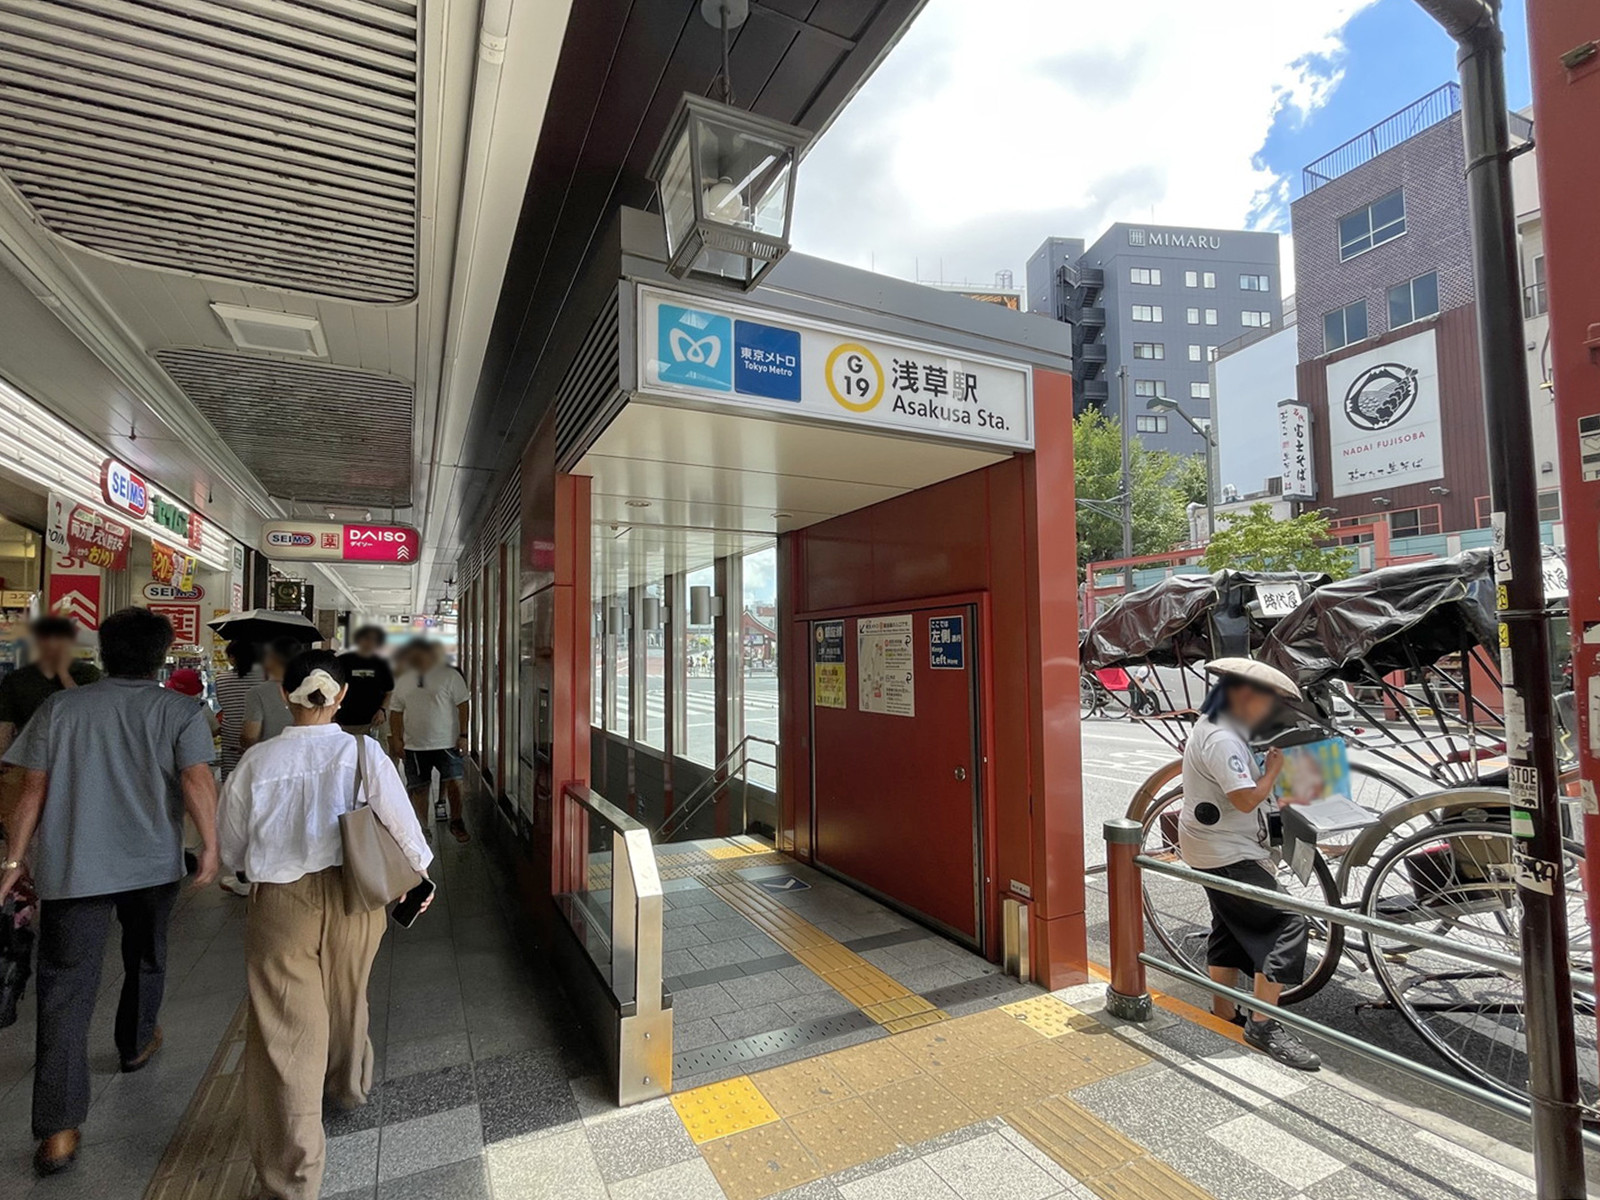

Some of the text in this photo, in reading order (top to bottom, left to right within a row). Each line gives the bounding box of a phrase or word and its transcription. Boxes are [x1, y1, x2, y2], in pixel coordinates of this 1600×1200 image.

[1149, 233, 1220, 249] MIMARU
[740, 347, 796, 368] 東京メトロ
[847, 354, 863, 374] G
[744, 360, 793, 377] Tokyo Metro
[844, 375, 870, 398] 19
[891, 358, 979, 404] 浅草駅
[892, 394, 1010, 432] Asakusa Sta.
[1343, 431, 1425, 456] NADAI FUJISOBA
[112, 471, 145, 508] SEIMS
[272, 534, 311, 544] SEIMS
[350, 530, 407, 542] DAISO
[931, 629, 951, 644] 左側
[931, 654, 947, 665] Left
